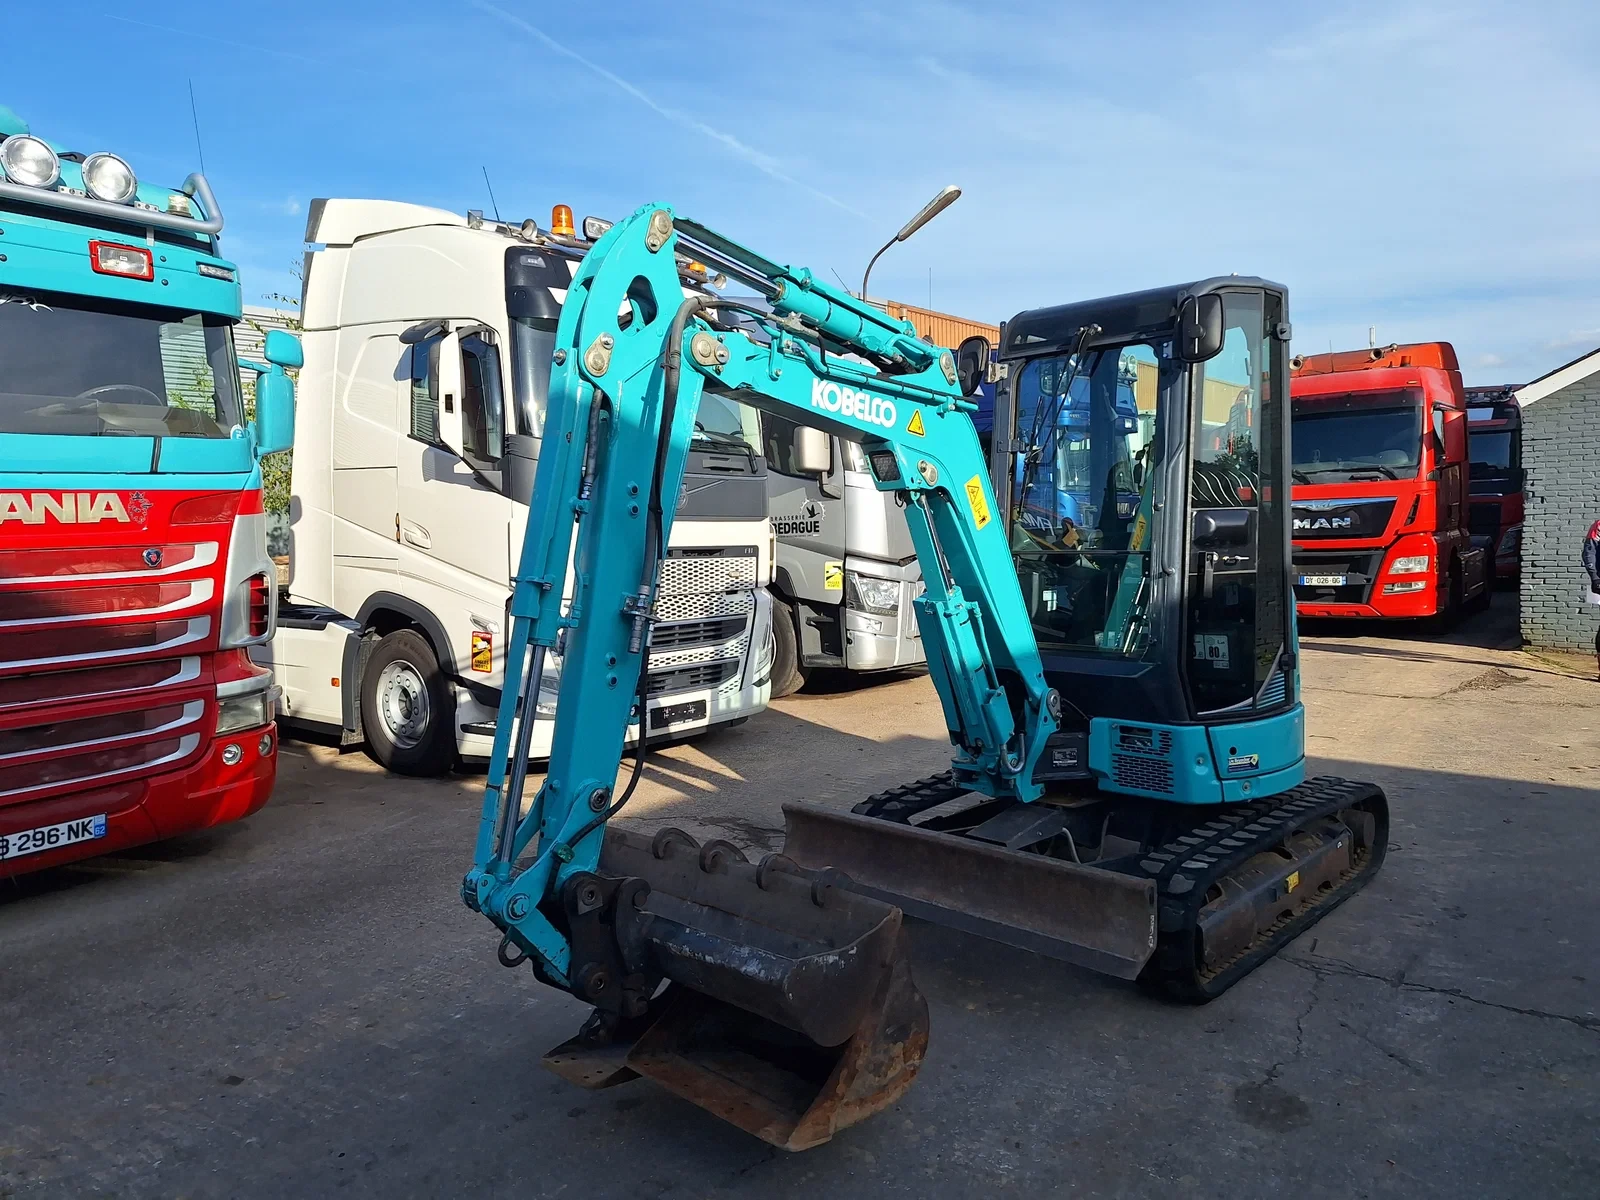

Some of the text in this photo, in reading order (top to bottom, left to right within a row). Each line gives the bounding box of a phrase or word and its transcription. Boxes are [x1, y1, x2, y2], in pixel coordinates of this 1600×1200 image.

[811, 377, 897, 428] KOBELCO
[0, 493, 131, 524] ANIA
[1293, 517, 1351, 530] MAN
[1209, 646, 1220, 658] 80
[95, 826, 105, 834] 62
